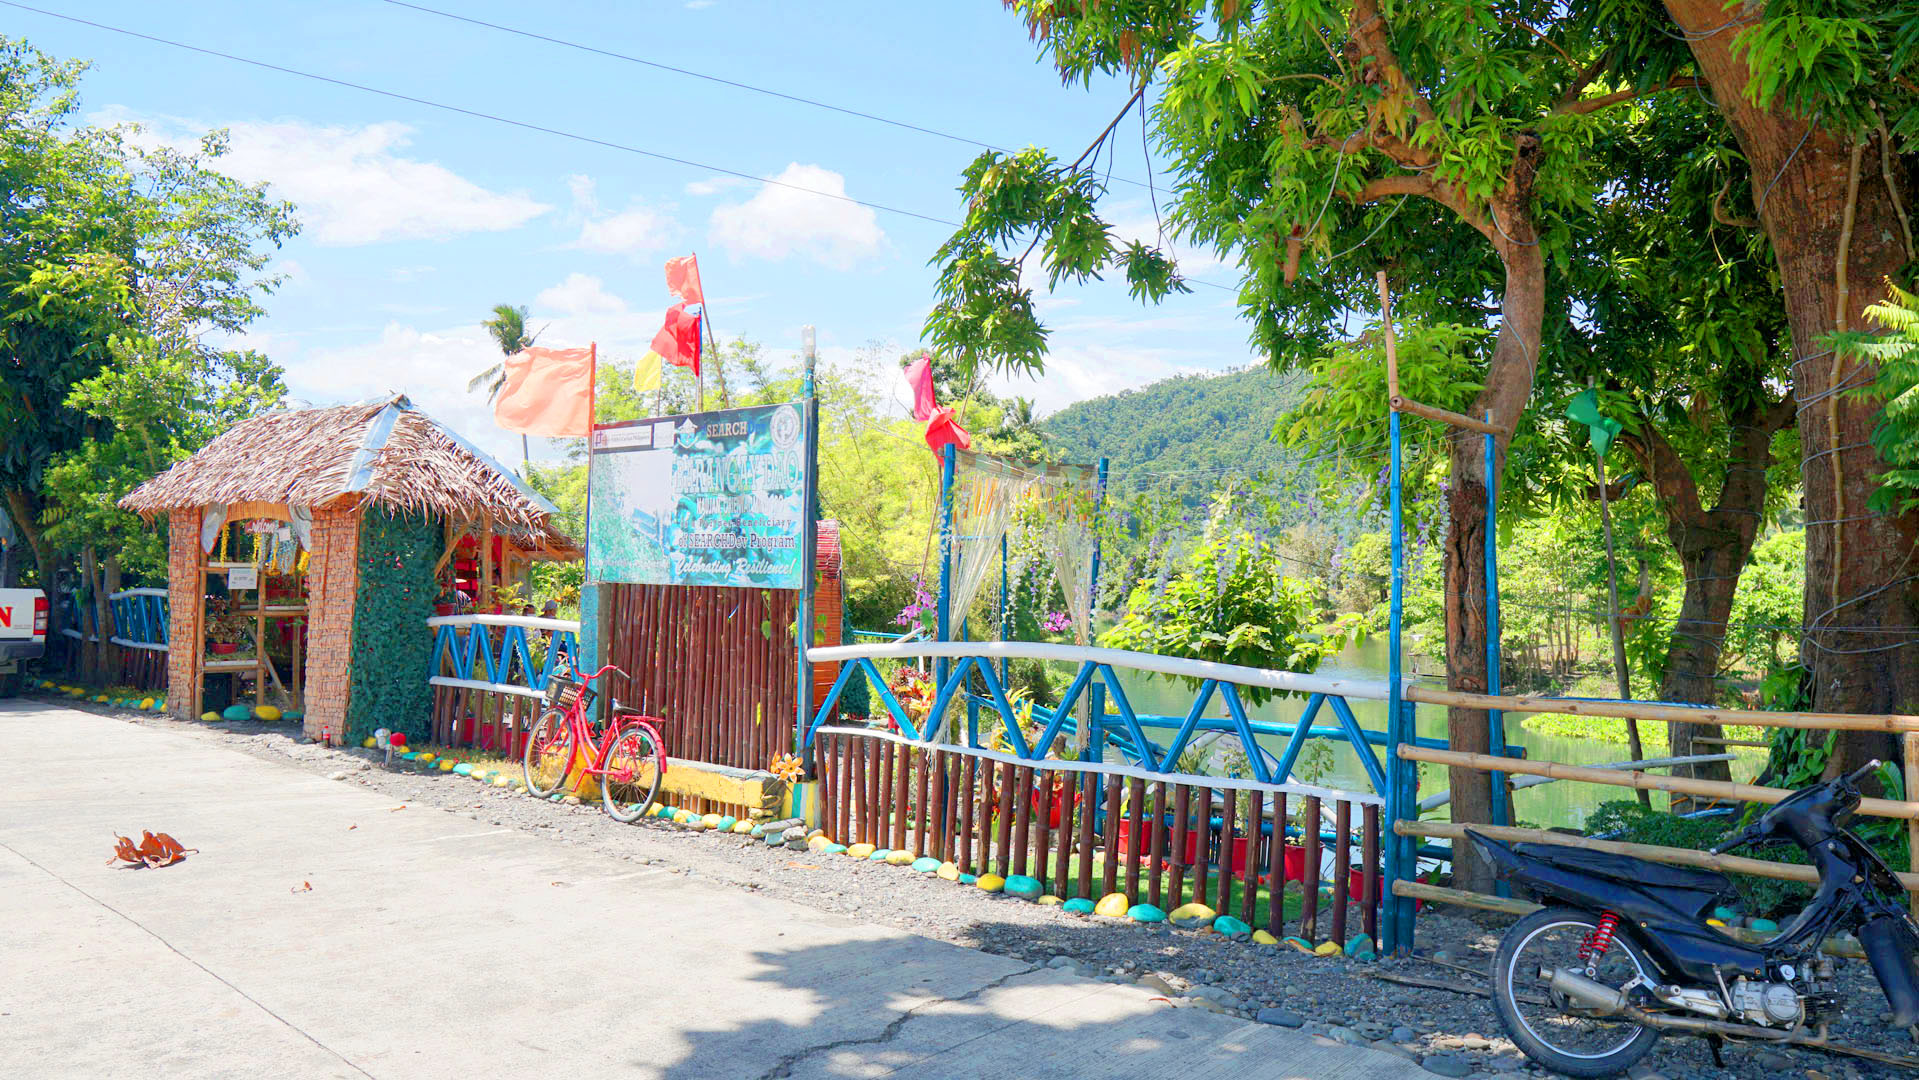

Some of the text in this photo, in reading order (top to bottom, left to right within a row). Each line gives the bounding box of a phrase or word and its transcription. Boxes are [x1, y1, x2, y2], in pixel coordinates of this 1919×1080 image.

[761, 449, 800, 490] DAO
[750, 533, 795, 551] Program
[676, 556, 732, 579] Celebrating
